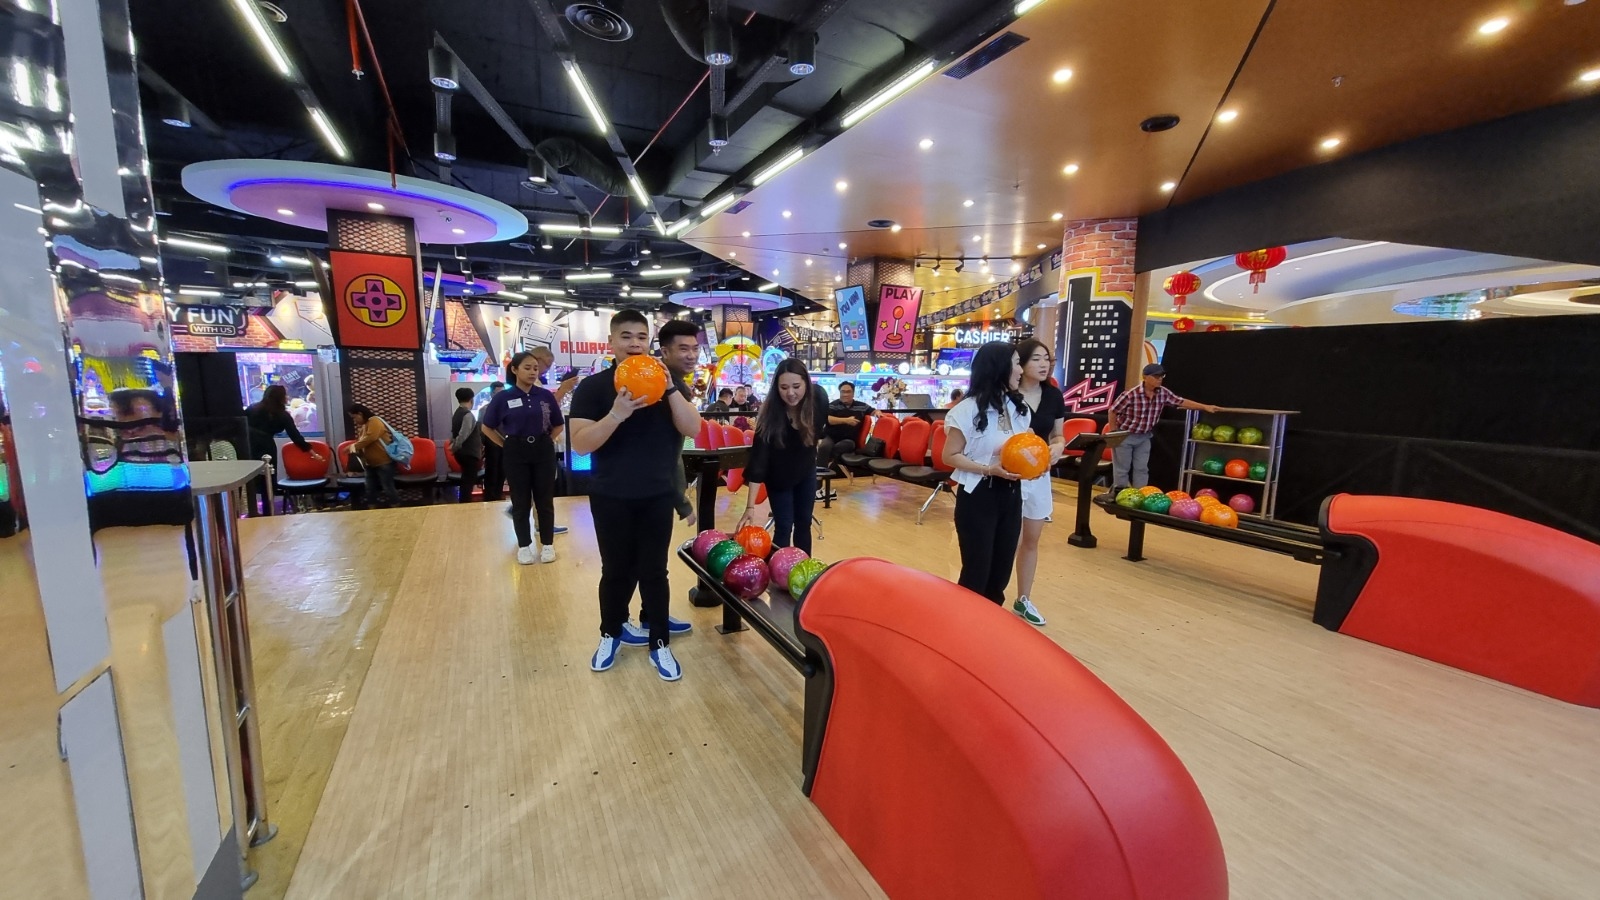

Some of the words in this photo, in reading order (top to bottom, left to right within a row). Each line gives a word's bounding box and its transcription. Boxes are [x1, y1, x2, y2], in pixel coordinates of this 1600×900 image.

[885, 288, 917, 300] PLAY
[187, 307, 234, 325] FUN
[192, 325, 218, 333] WITH
[955, 329, 1009, 344] CASHIER
